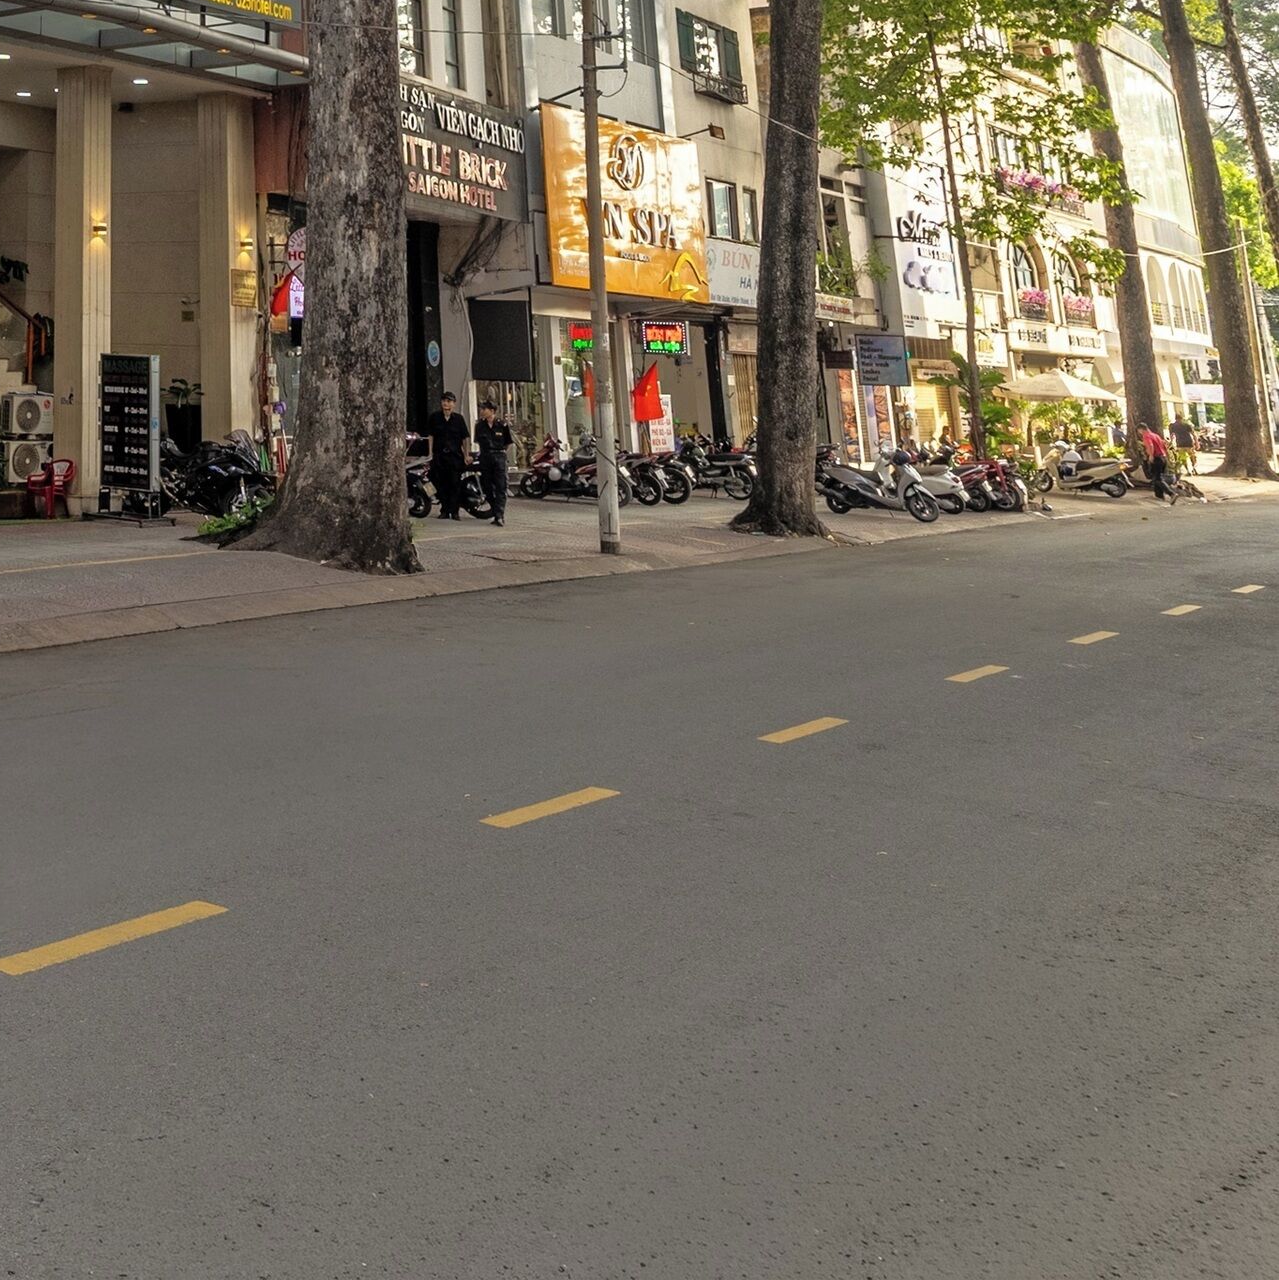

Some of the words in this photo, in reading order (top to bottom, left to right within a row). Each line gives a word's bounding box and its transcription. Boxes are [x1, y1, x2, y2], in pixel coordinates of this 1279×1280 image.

[400, 106, 425, 134] GÒN
[410, 87, 435, 113] SẠN
[436, 101, 468, 136] VIÊN
[468, 112, 500, 149] GẠCH
[500, 120, 525, 154] NHỎ
[402, 133, 452, 176] ITTLE
[459, 149, 508, 190] BRICK
[408, 171, 458, 201] SAIGON
[460, 183, 497, 211] HOTEL
[631, 207, 683, 250] SPA
[721, 248, 753, 270] BÚN
